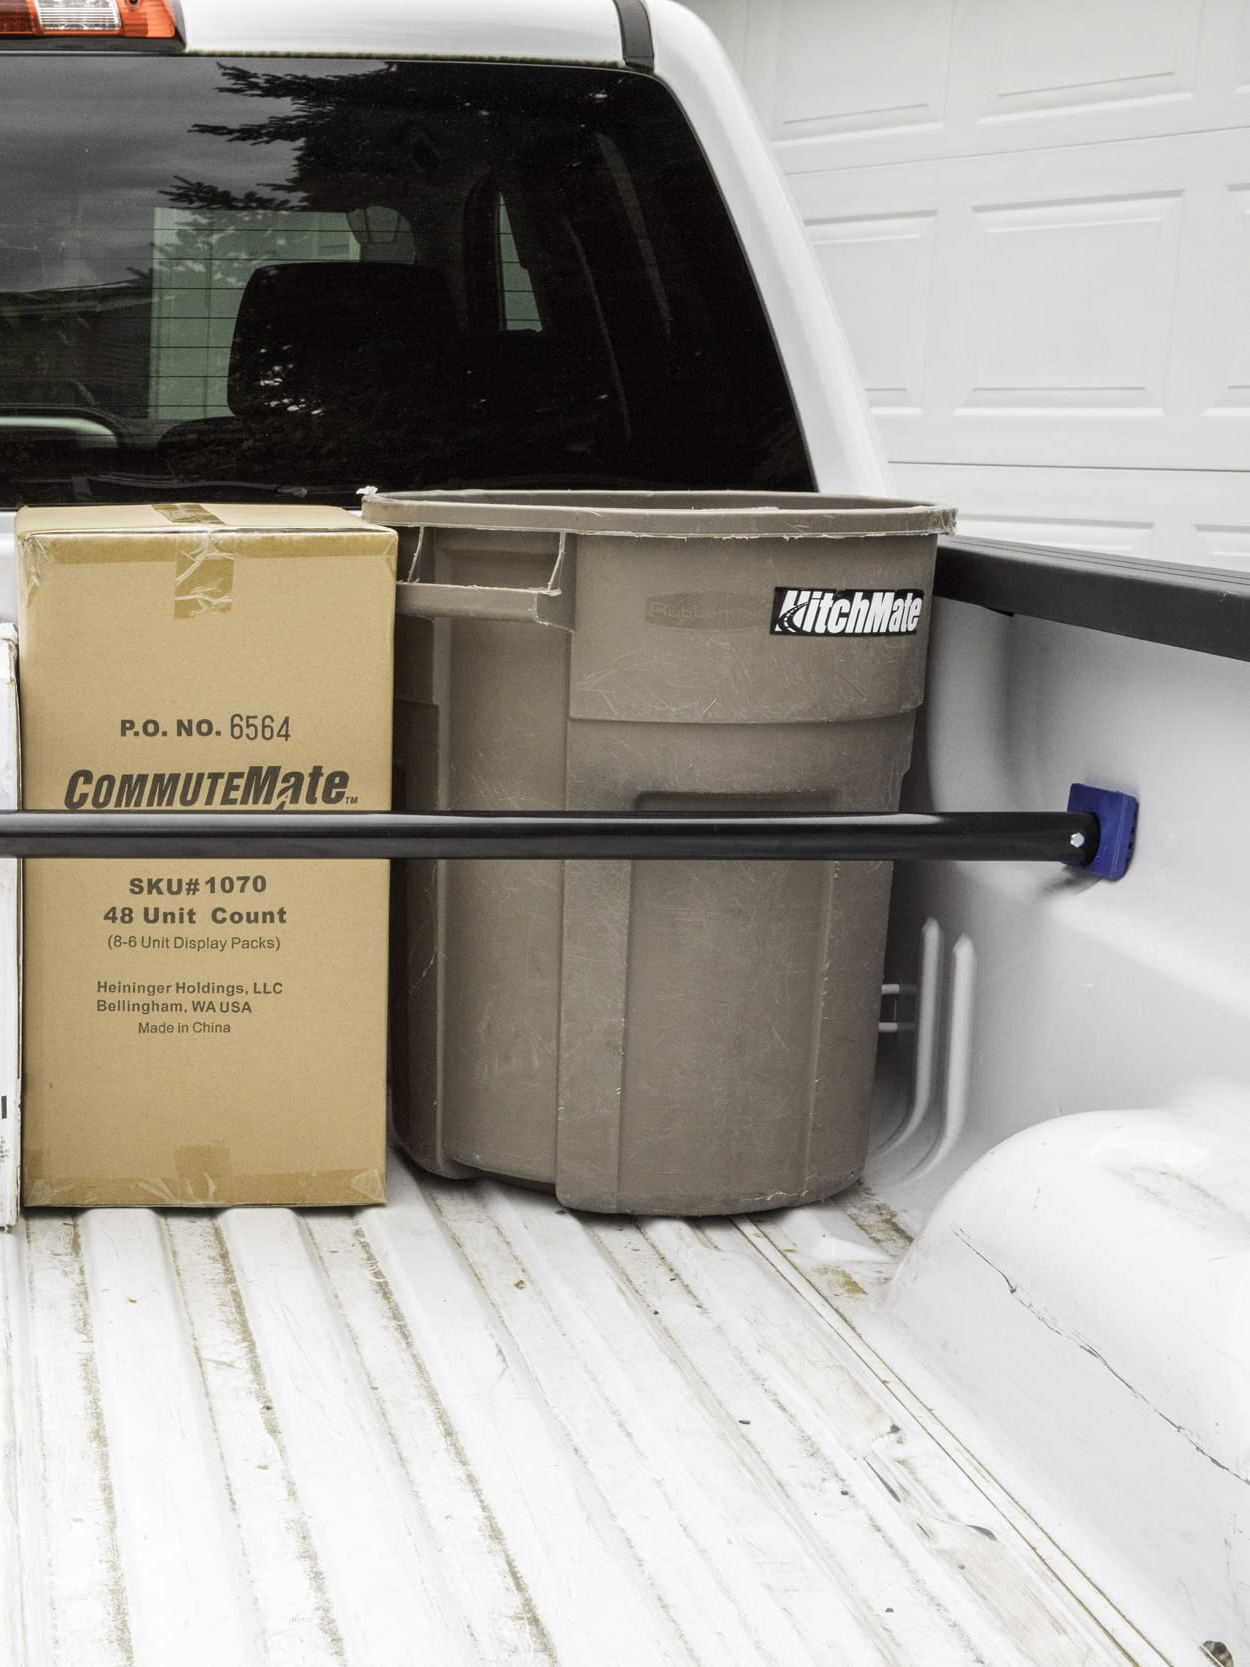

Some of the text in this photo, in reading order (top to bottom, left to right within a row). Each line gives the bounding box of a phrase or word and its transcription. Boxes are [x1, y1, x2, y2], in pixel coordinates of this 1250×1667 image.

[775, 590, 923, 634] HitchMate
[120, 714, 291, 741] P.O. NO. 6564
[103, 906, 286, 924] 48 Unit Count
[107, 935, 280, 952] (8-6 Unit Display Packs)
[97, 981, 283, 996] Heininger Holdings, LLC
[97, 1000, 252, 1015] Bellingham, WA USA
[138, 1022, 231, 1034] Made in China
